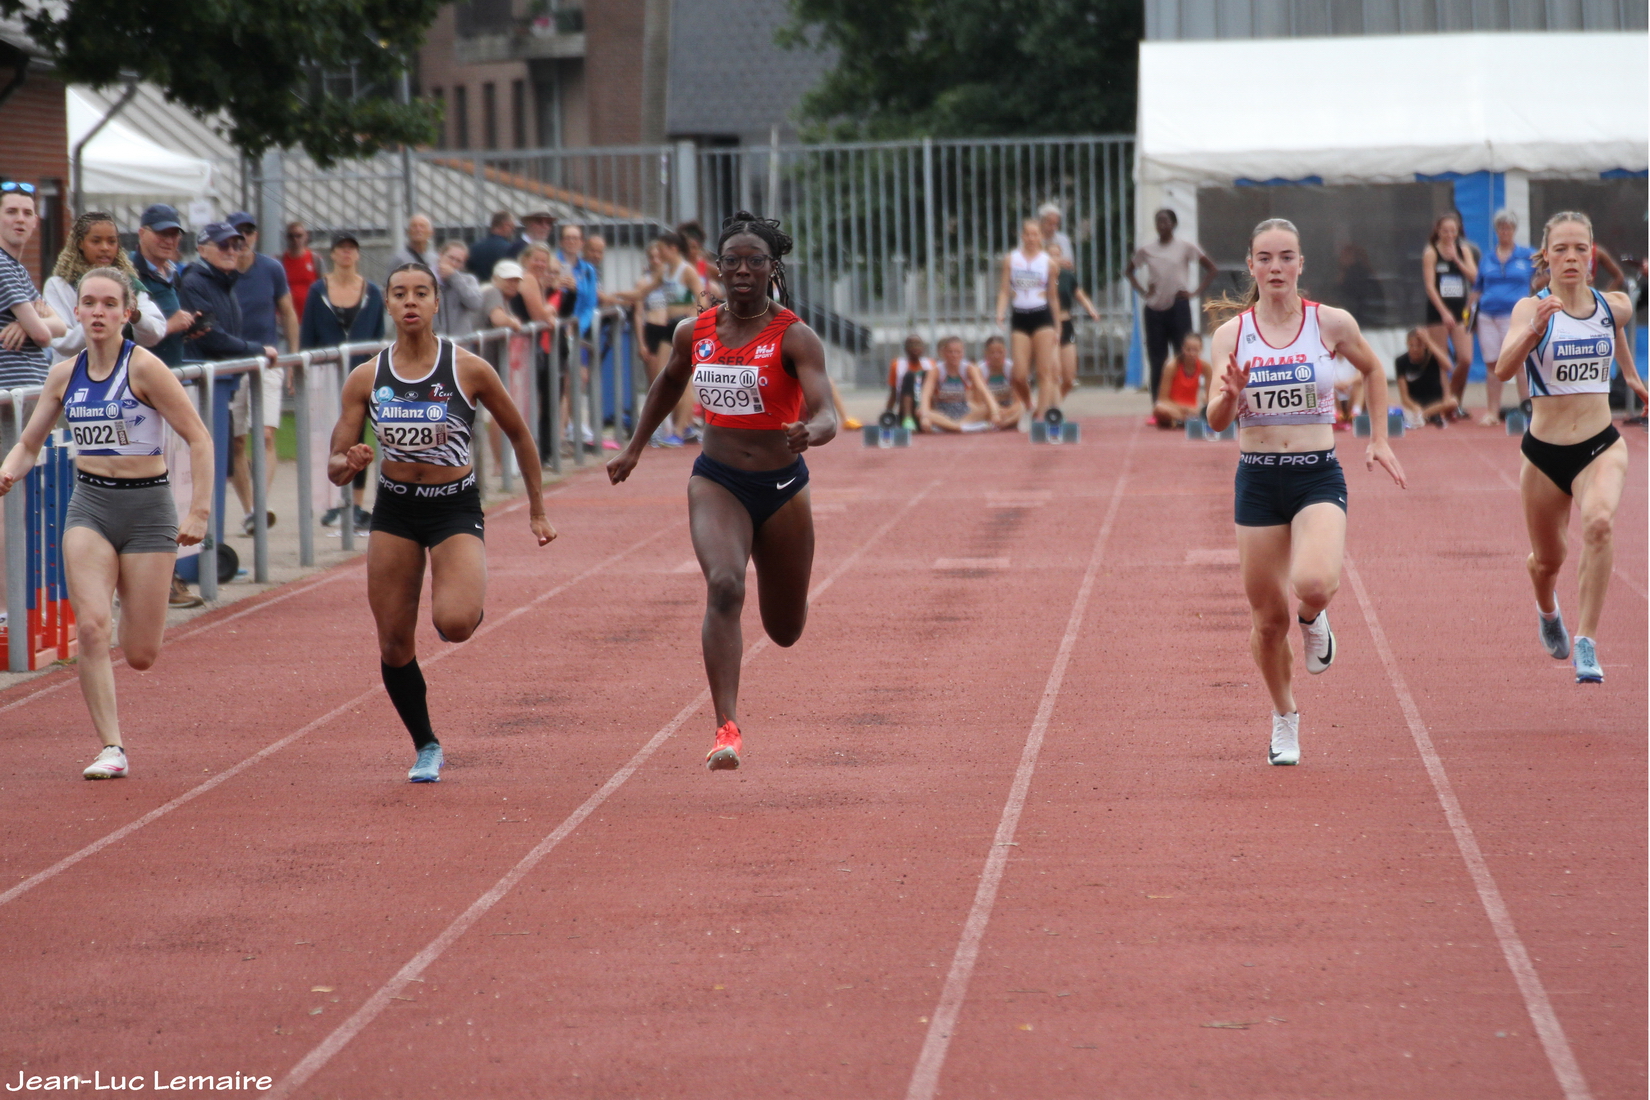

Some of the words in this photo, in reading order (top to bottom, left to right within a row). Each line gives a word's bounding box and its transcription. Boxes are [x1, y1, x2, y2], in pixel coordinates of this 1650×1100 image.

[755, 343, 776, 355] MJ
[1557, 344, 1594, 356] Allianz
[694, 370, 737, 384] Allianz
[1249, 369, 1293, 383] Allianz
[1556, 362, 1599, 382] 6025
[699, 388, 750, 408] 6269
[1252, 388, 1303, 409] 1765
[69, 406, 104, 418] Allianz
[381, 406, 424, 418] Allianz
[74, 425, 115, 445] 6022
[383, 427, 433, 446] 5228
[1240, 453, 1276, 465] NIKE
[1279, 454, 1319, 466] PRO
[380, 474, 407, 494] PRO
[415, 483, 459, 497] NIKE
[461, 473, 475, 491] PR
